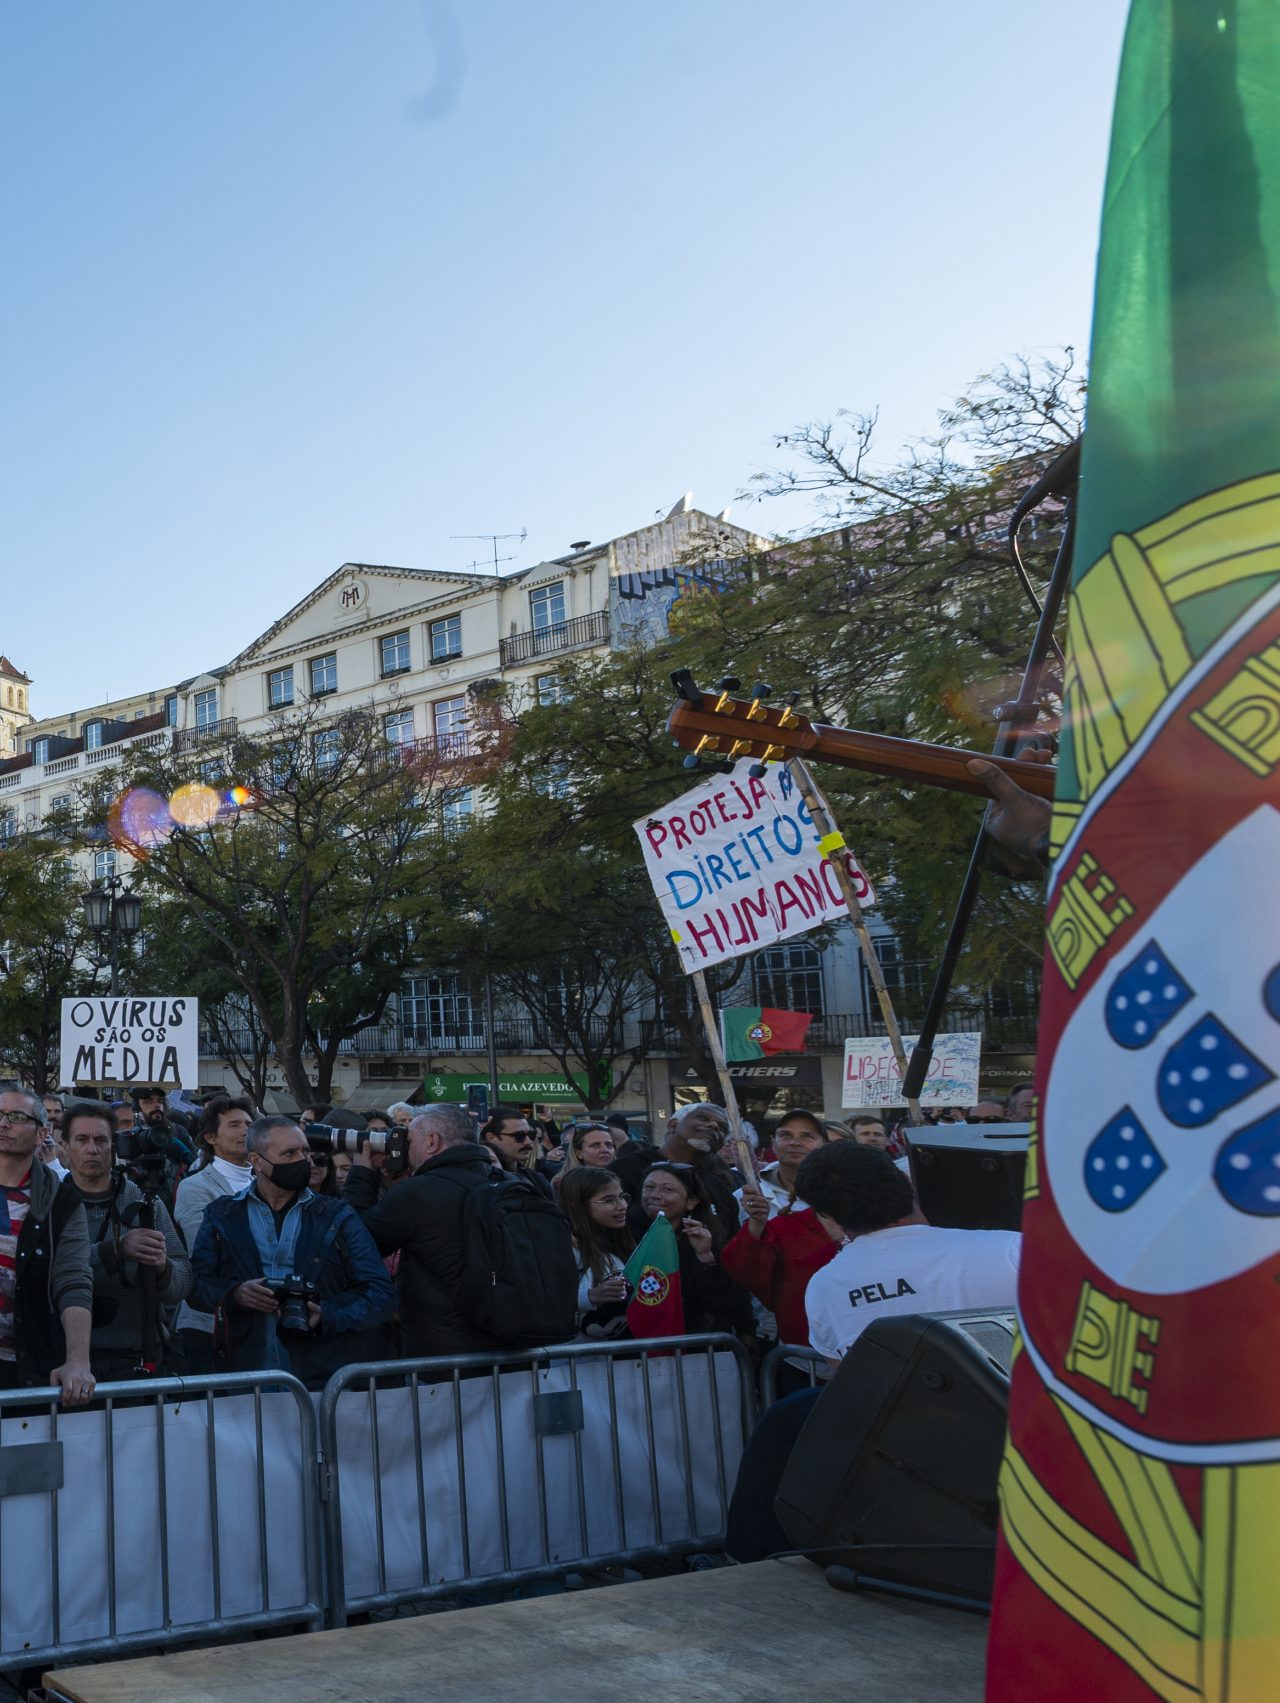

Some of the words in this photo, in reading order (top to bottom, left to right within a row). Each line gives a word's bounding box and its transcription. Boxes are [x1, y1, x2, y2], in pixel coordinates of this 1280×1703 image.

[645, 776, 776, 859] PROTEJA
[686, 852, 869, 957] HUMANOS
[71, 1001, 94, 1028] O
[100, 999, 186, 1028] VÍRUS
[94, 1026, 132, 1043] SÃO
[141, 1027, 167, 1043] OS
[72, 1044, 181, 1082] MÉDIA
[847, 1055, 956, 1080] LIBERDE
[520, 1083, 580, 1092] AZEVEDO
[848, 1278, 917, 1308] PELA
